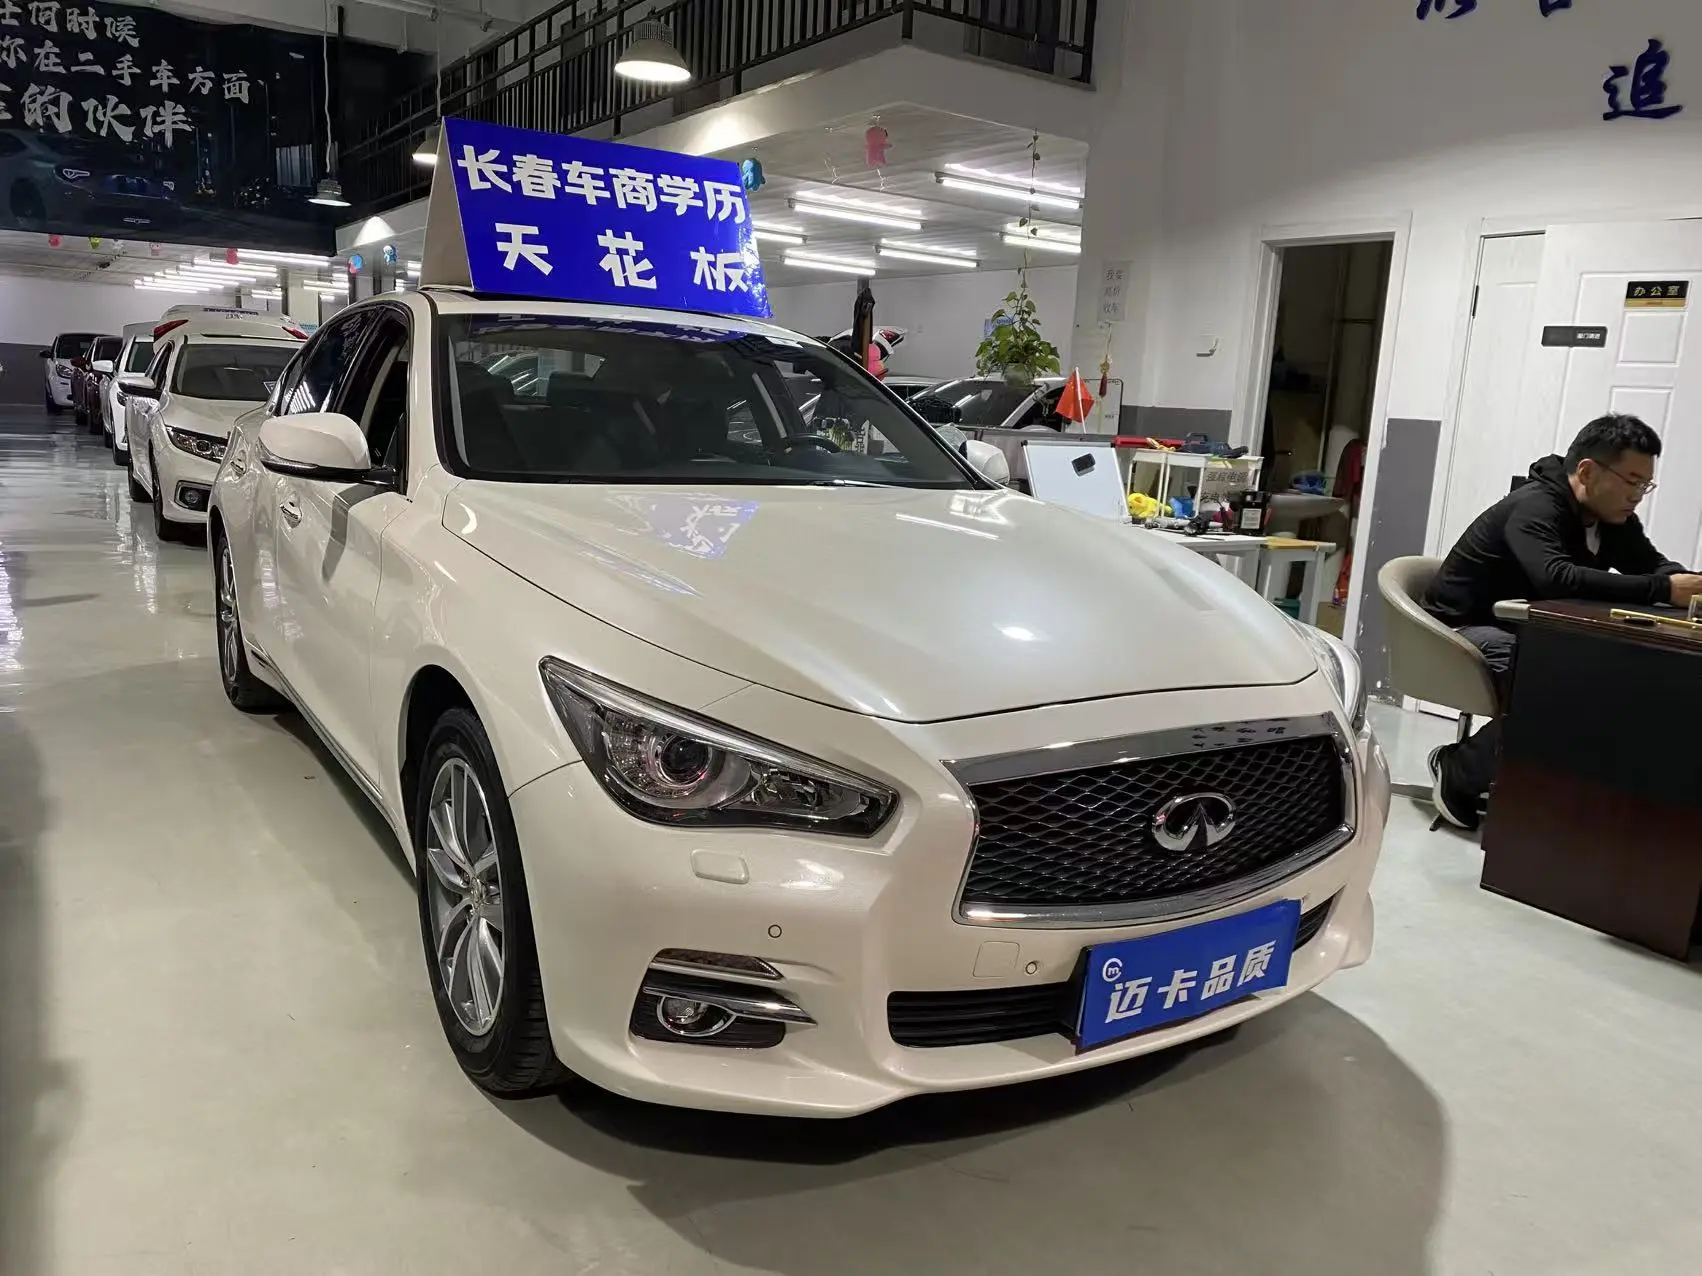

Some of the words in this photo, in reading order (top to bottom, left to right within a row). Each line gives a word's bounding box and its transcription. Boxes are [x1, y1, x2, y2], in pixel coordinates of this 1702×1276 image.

[0, 82, 193, 148] 的伙伴
[1602, 38, 1683, 121] 追
[457, 144, 746, 226] 长春车商学历
[494, 222, 749, 293] 天花板
[1633, 285, 1680, 297] 办公室
[1104, 939, 1277, 1025] 迈卡品质
